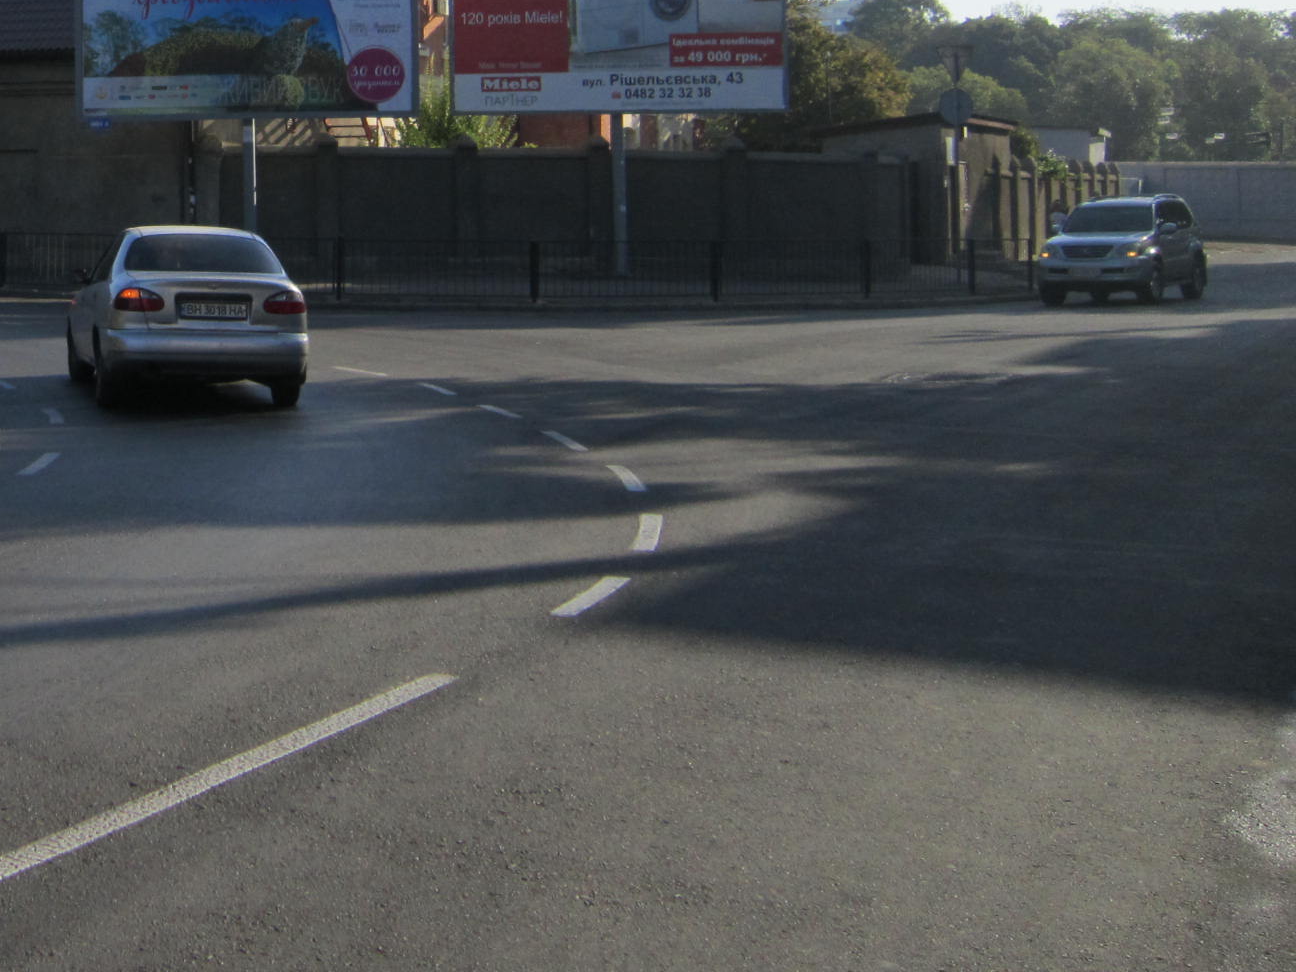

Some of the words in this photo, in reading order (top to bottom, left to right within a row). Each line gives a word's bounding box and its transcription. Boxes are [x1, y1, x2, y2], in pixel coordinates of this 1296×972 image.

[461, 12, 484, 25] 120
[487, 11, 521, 27] років
[525, 10, 563, 24] Miele!
[688, 51, 703, 62] 49
[707, 51, 732, 62] 000
[482, 78, 540, 91] Miele
[582, 78, 606, 88] вул.
[726, 71, 744, 84] 43
[624, 88, 655, 99] 0482
[659, 88, 674, 99] 32
[678, 88, 693, 98] 32
[697, 87, 711, 98] 38
